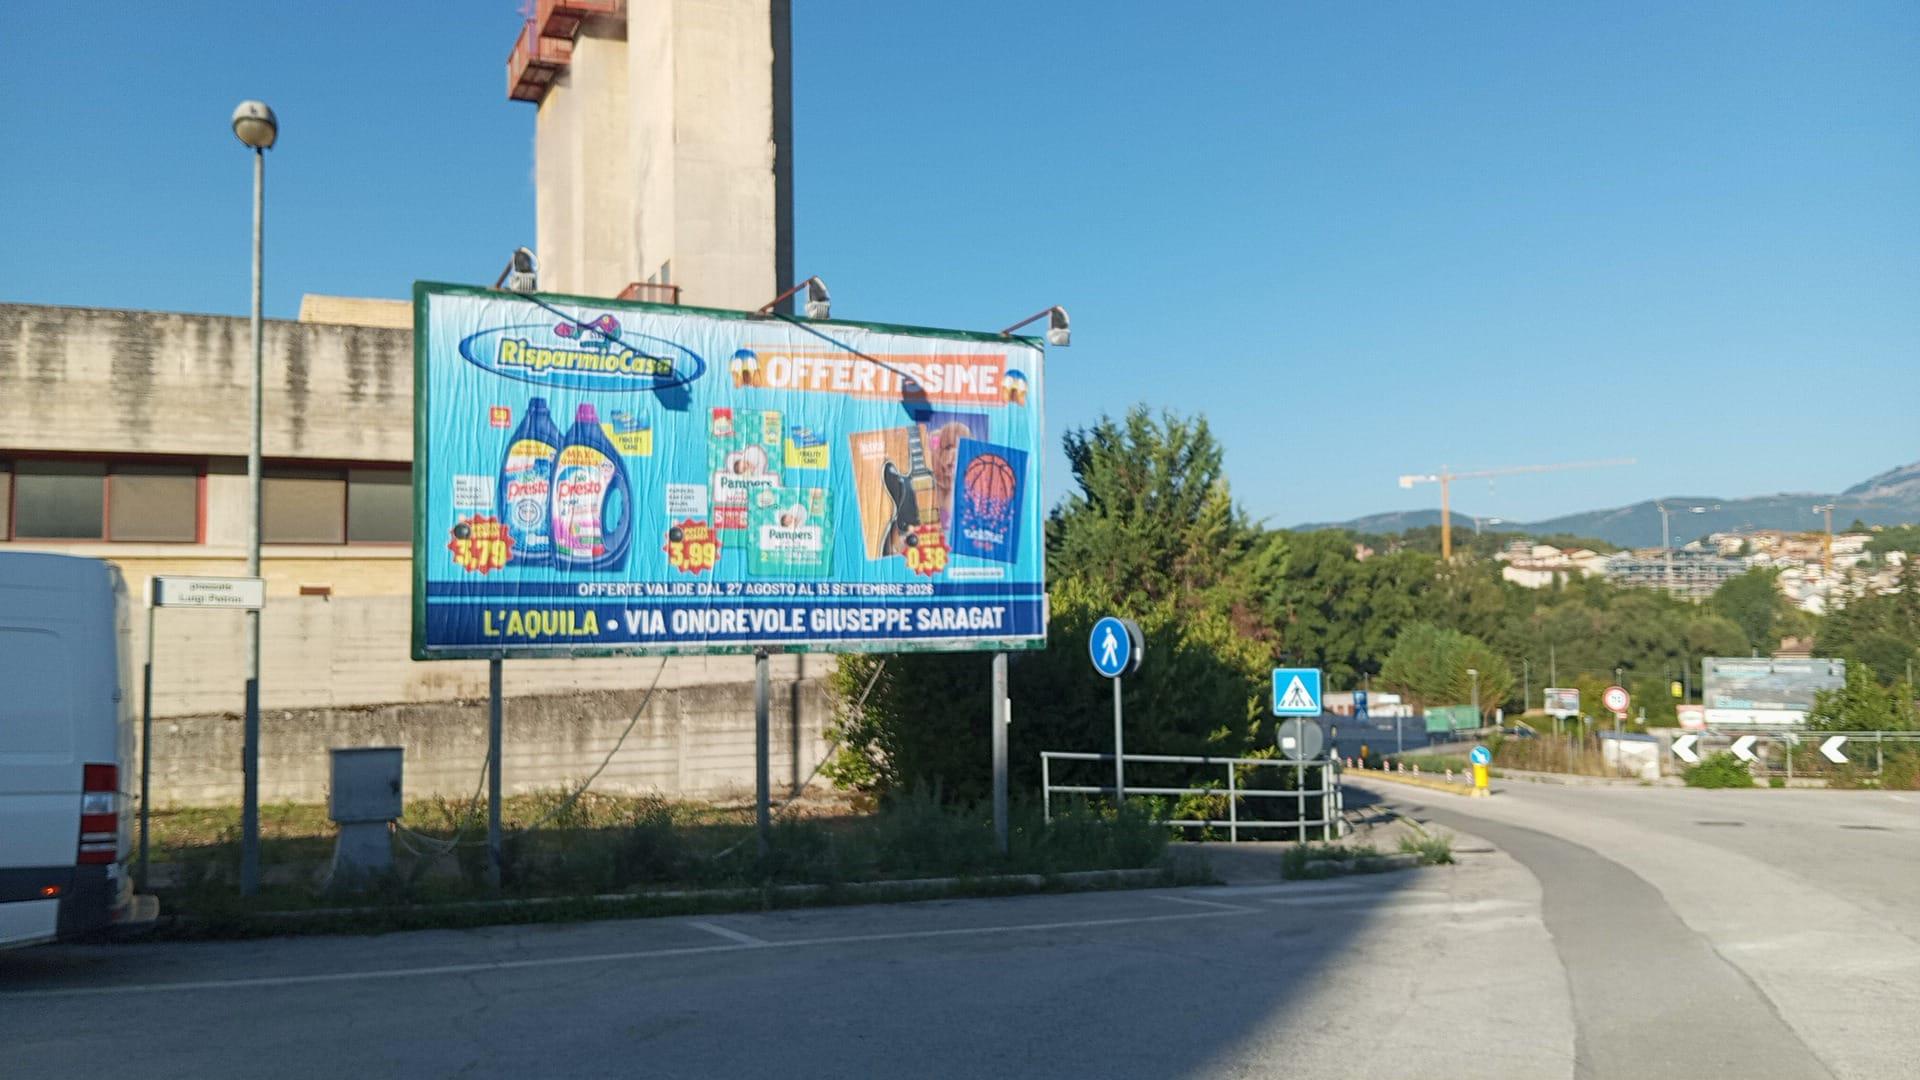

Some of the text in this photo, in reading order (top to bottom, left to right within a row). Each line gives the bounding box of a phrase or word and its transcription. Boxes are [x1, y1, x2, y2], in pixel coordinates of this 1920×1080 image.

[766, 355, 999, 395] OFFERTISSIME
[769, 529, 813, 541] Pampers
[670, 542, 715, 569] 3,99
[578, 583, 643, 596] OFFERTE
[646, 583, 695, 596] VALIDE
[698, 583, 724, 596] DAL
[727, 583, 742, 596] 27
[746, 583, 796, 596] AGOSTO
[798, 583, 815, 596] AL
[832, 583, 905, 596] SETTEMBRE
[484, 606, 1005, 638] L'AQUILA VIA ONOREVOLE GIUSEPPE SARAGAT
